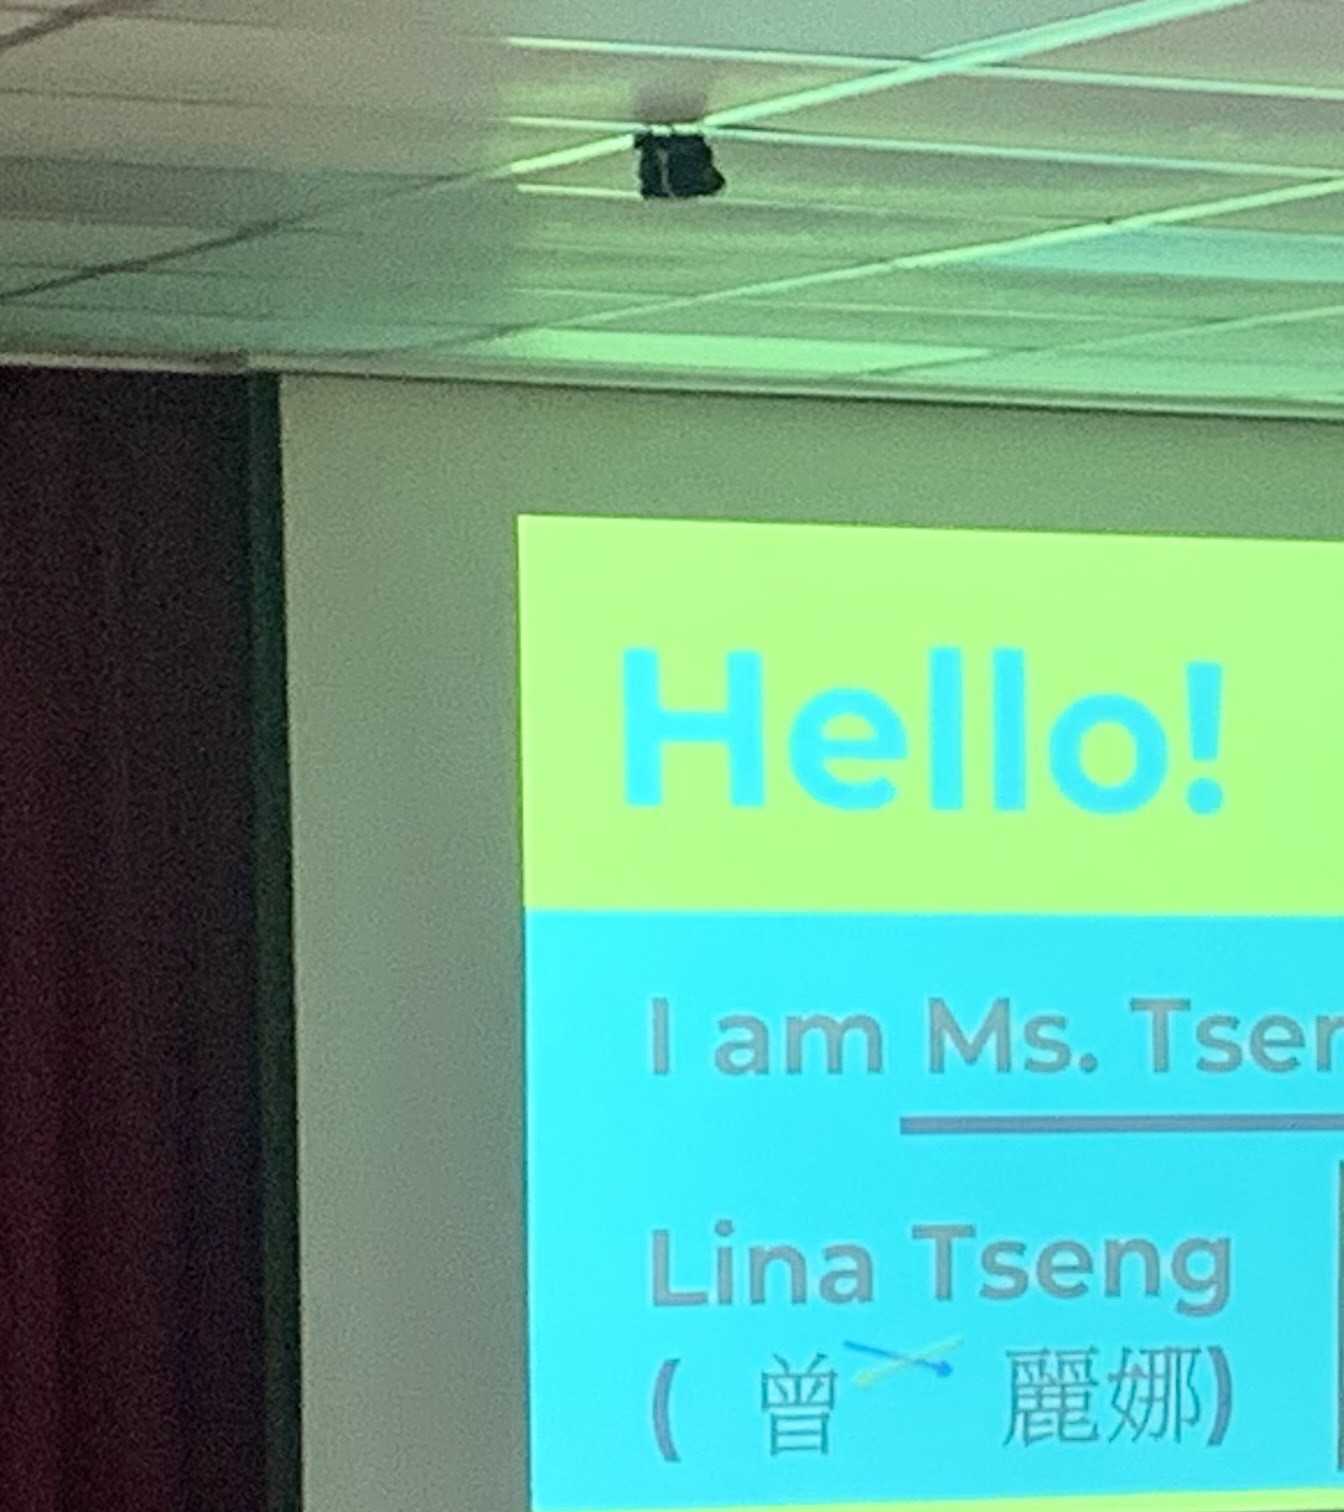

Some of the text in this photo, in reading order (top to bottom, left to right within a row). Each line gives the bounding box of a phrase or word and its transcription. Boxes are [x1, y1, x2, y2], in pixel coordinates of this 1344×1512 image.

[622, 645, 1225, 817] Hello!
[652, 998, 670, 1076] I
[713, 1013, 884, 1076] am
[928, 997, 1099, 1075] Ms.
[652, 1219, 1233, 1319] Lina Tseng
